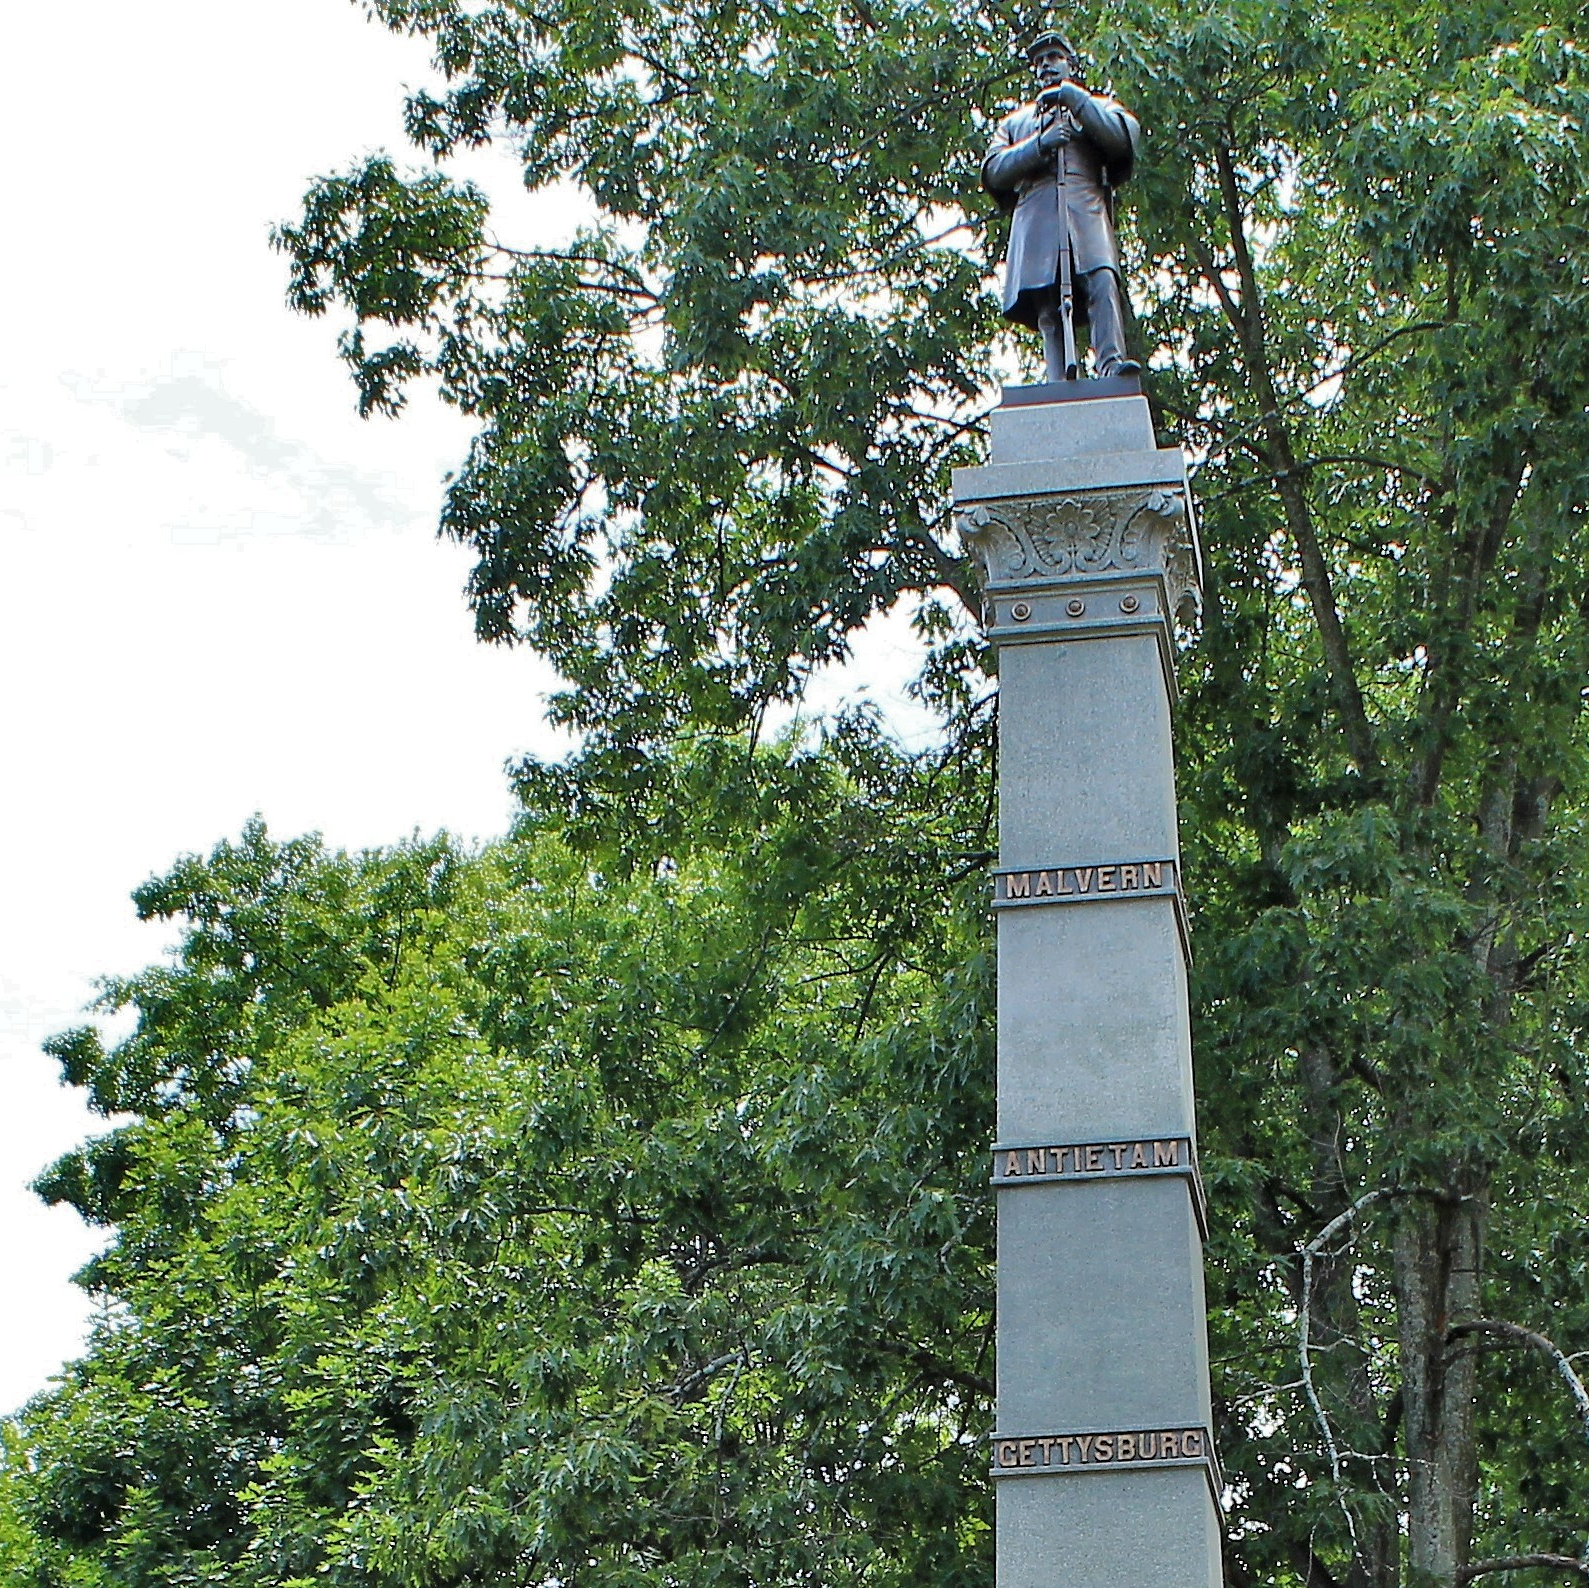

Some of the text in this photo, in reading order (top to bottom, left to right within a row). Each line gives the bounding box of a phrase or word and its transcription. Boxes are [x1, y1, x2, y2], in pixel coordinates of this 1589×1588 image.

[1006, 862, 1162, 898] MALVERN
[1004, 1141, 1178, 1176] ANTIETAM
[998, 1430, 1203, 1468] GETTYSBURG
